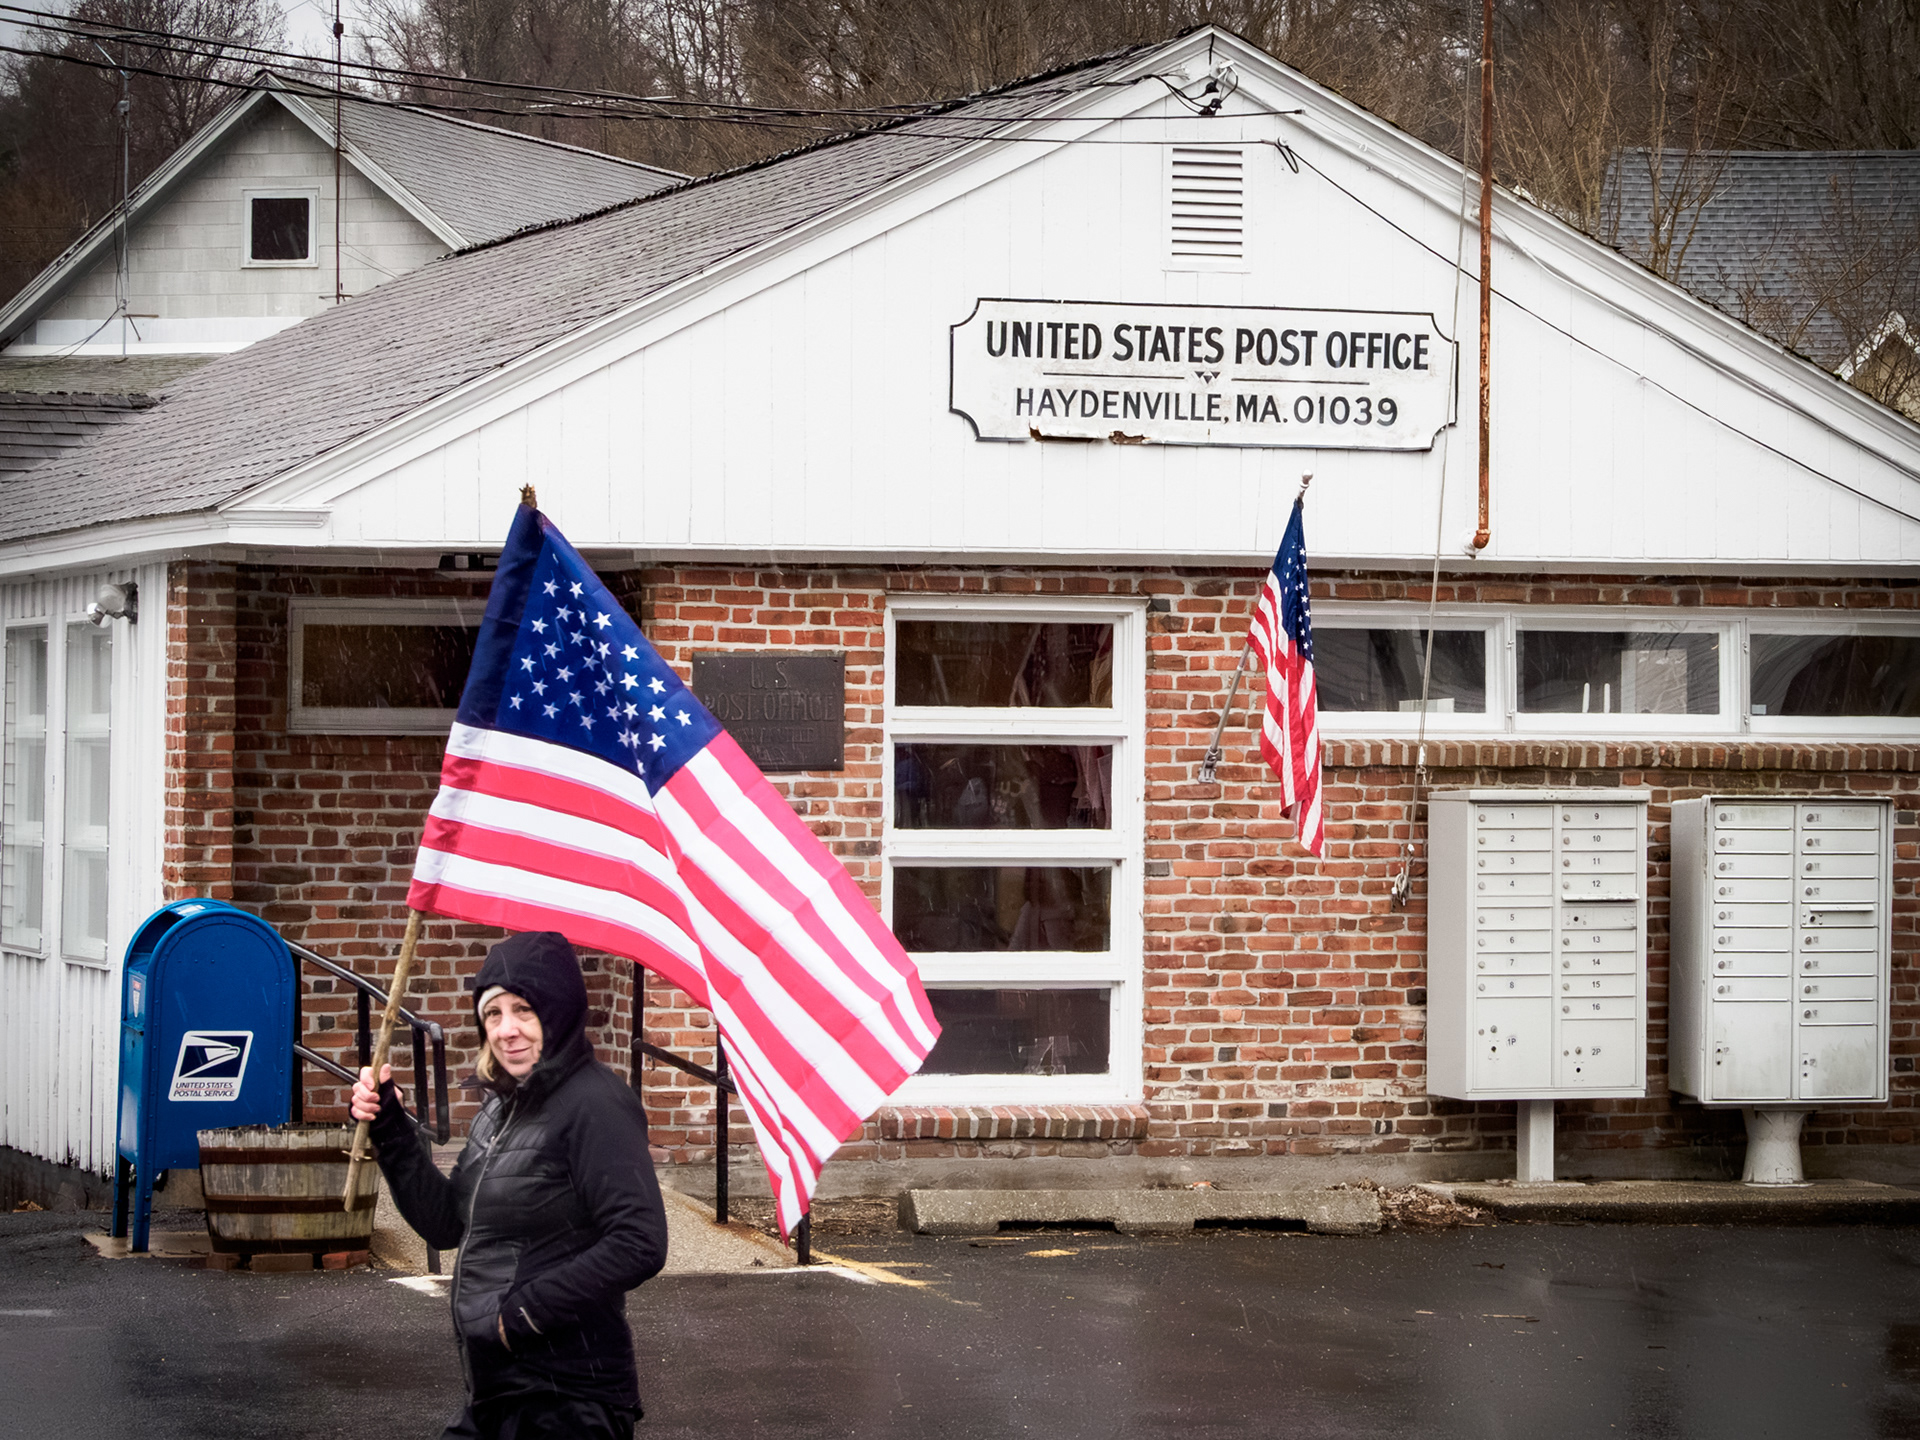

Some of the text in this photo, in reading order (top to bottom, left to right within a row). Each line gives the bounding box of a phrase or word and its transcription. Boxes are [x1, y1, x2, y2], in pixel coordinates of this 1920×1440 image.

[986, 320, 1430, 371] UNITED STATES POST OFFICE
[1236, 394, 1288, 423] MA.
[1294, 396, 1398, 426] 01039
[763, 690, 836, 722] OFFICE
[1591, 834, 1601, 843] 10
[1591, 856, 1601, 866] 11
[1591, 880, 1601, 888] 12
[1591, 935, 1601, 944] 13
[1591, 958, 1601, 966] 14
[1591, 980, 1601, 989] 15
[1591, 1002, 1601, 1012] 16
[1507, 1037, 1517, 1047] 1P
[1591, 1047, 1602, 1056] 2P
